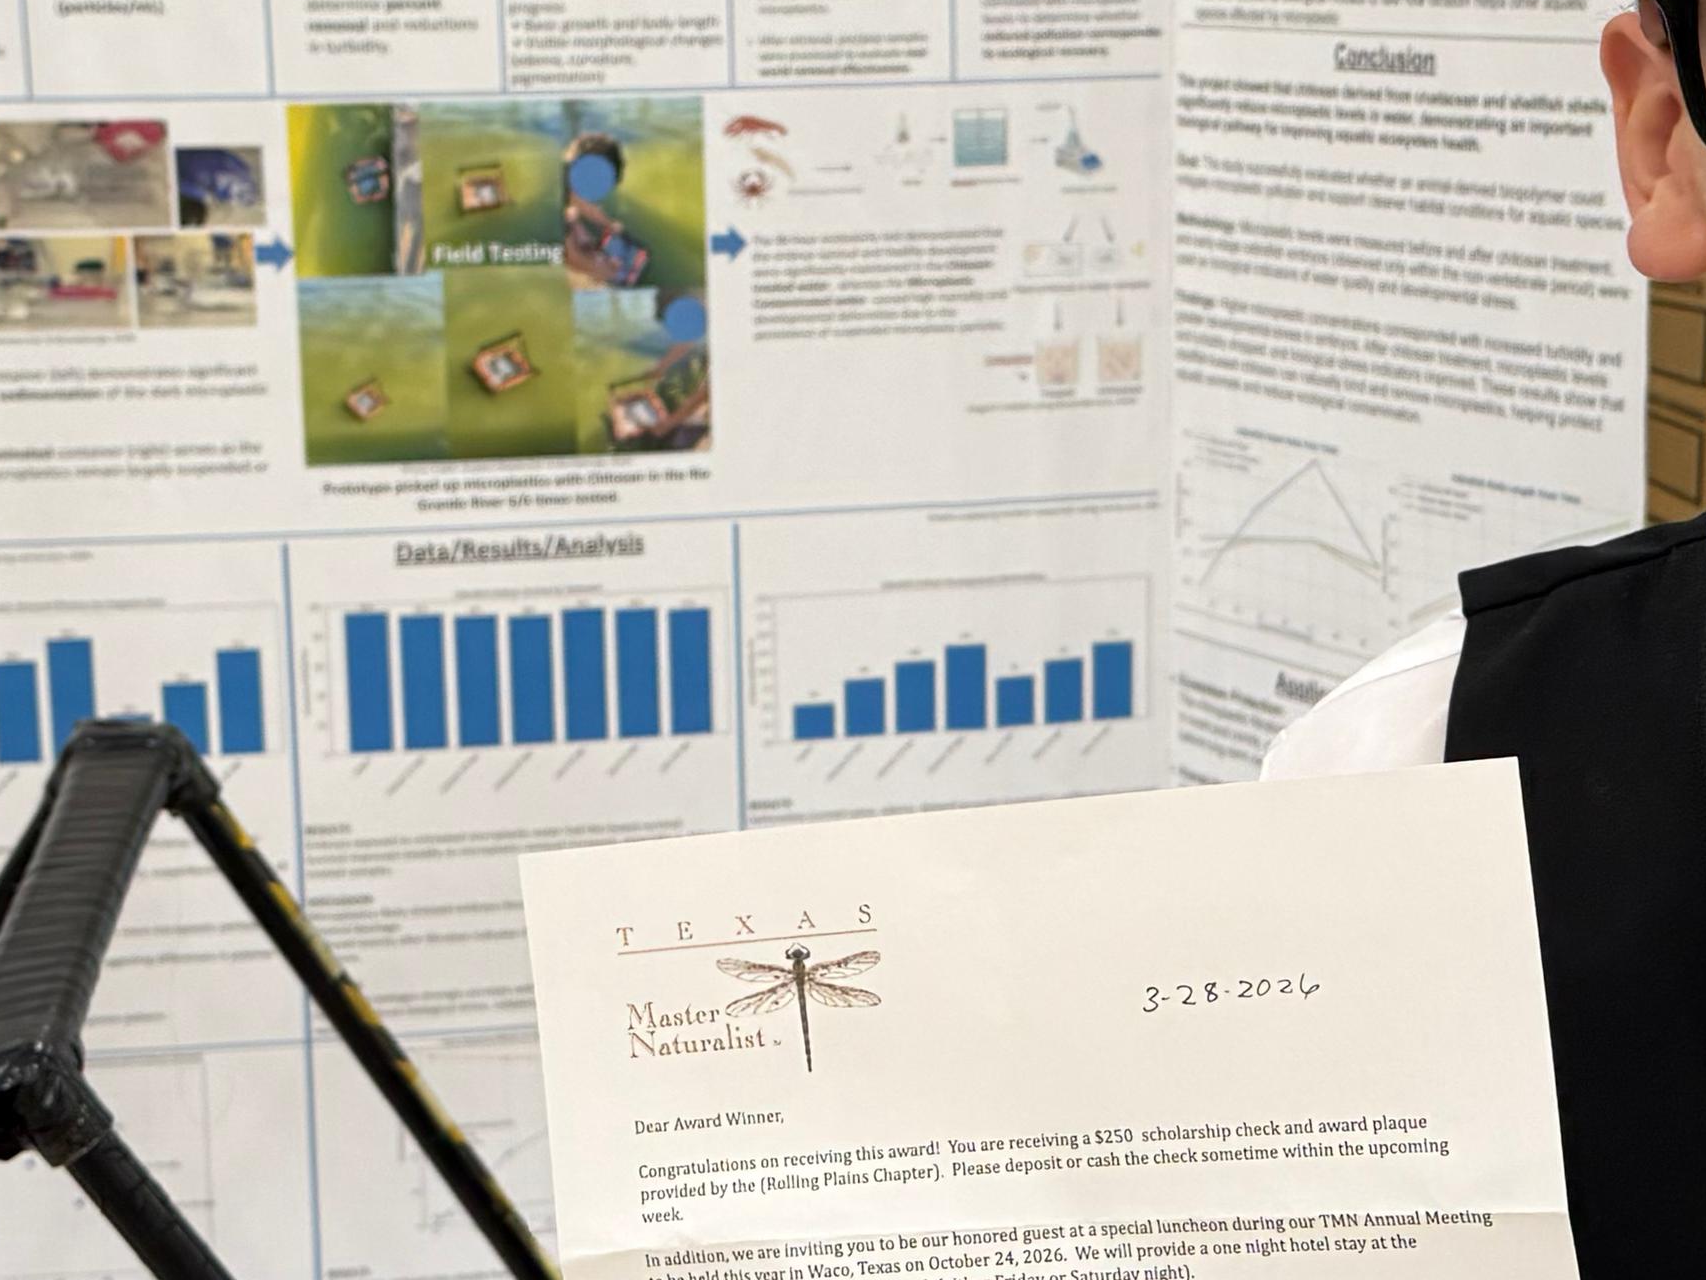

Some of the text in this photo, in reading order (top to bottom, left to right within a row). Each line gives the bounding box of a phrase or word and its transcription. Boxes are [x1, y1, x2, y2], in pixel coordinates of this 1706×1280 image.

[1334, 43, 1435, 74] Conclusion
[433, 242, 563, 268] Field Testing
[395, 533, 644, 566] Data/Results/Analysis
[1142, 973, 1320, 1013] 3-28-2026
[626, 1001, 720, 1031] Master
[634, 1111, 784, 1135] Dear Award Winner,
[638, 1114, 1427, 1181] Congratulations on receiving this award! You are receiving a $250 scholarship check and award plaque
[641, 1206, 684, 1224] week.
